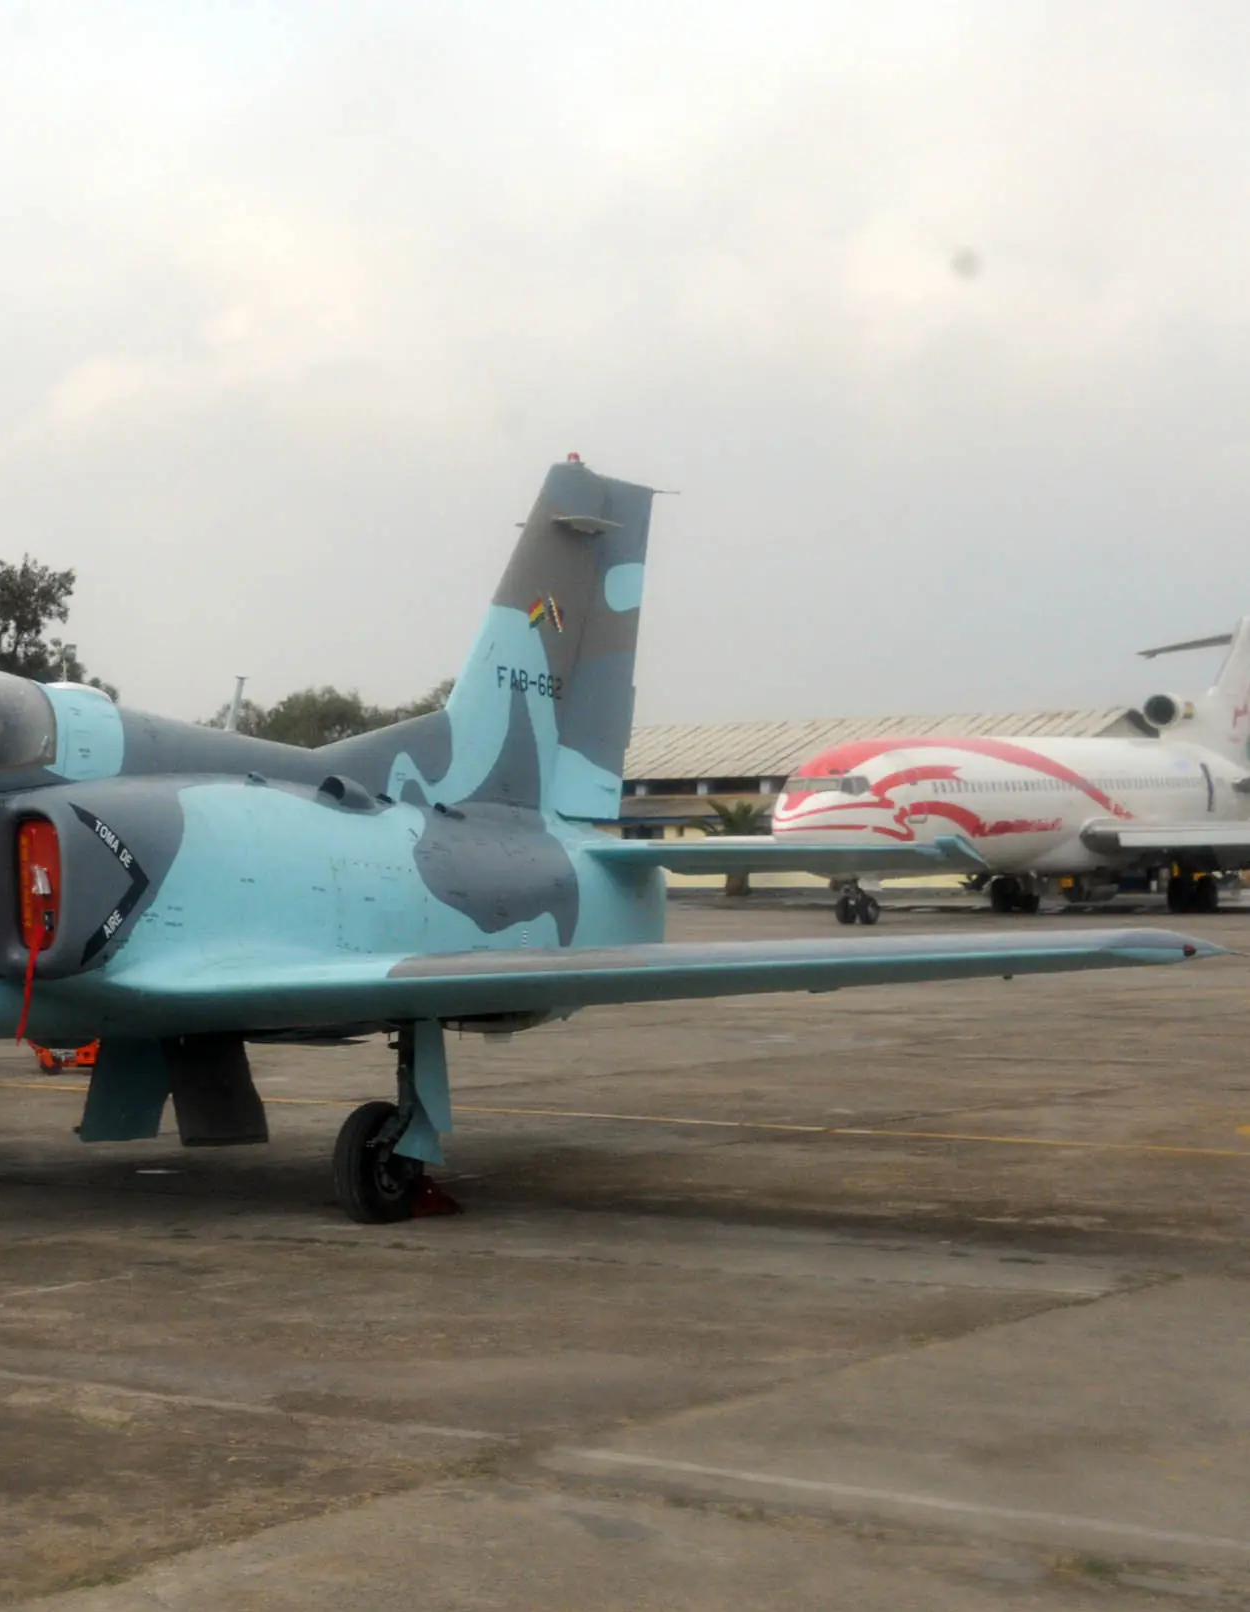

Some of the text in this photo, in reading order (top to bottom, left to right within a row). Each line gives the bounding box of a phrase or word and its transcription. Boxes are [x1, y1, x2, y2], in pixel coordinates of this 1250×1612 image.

[497, 666, 563, 700] FAB-662
[95, 820, 133, 868] TOMA DE
[103, 910, 123, 938] AIRE
